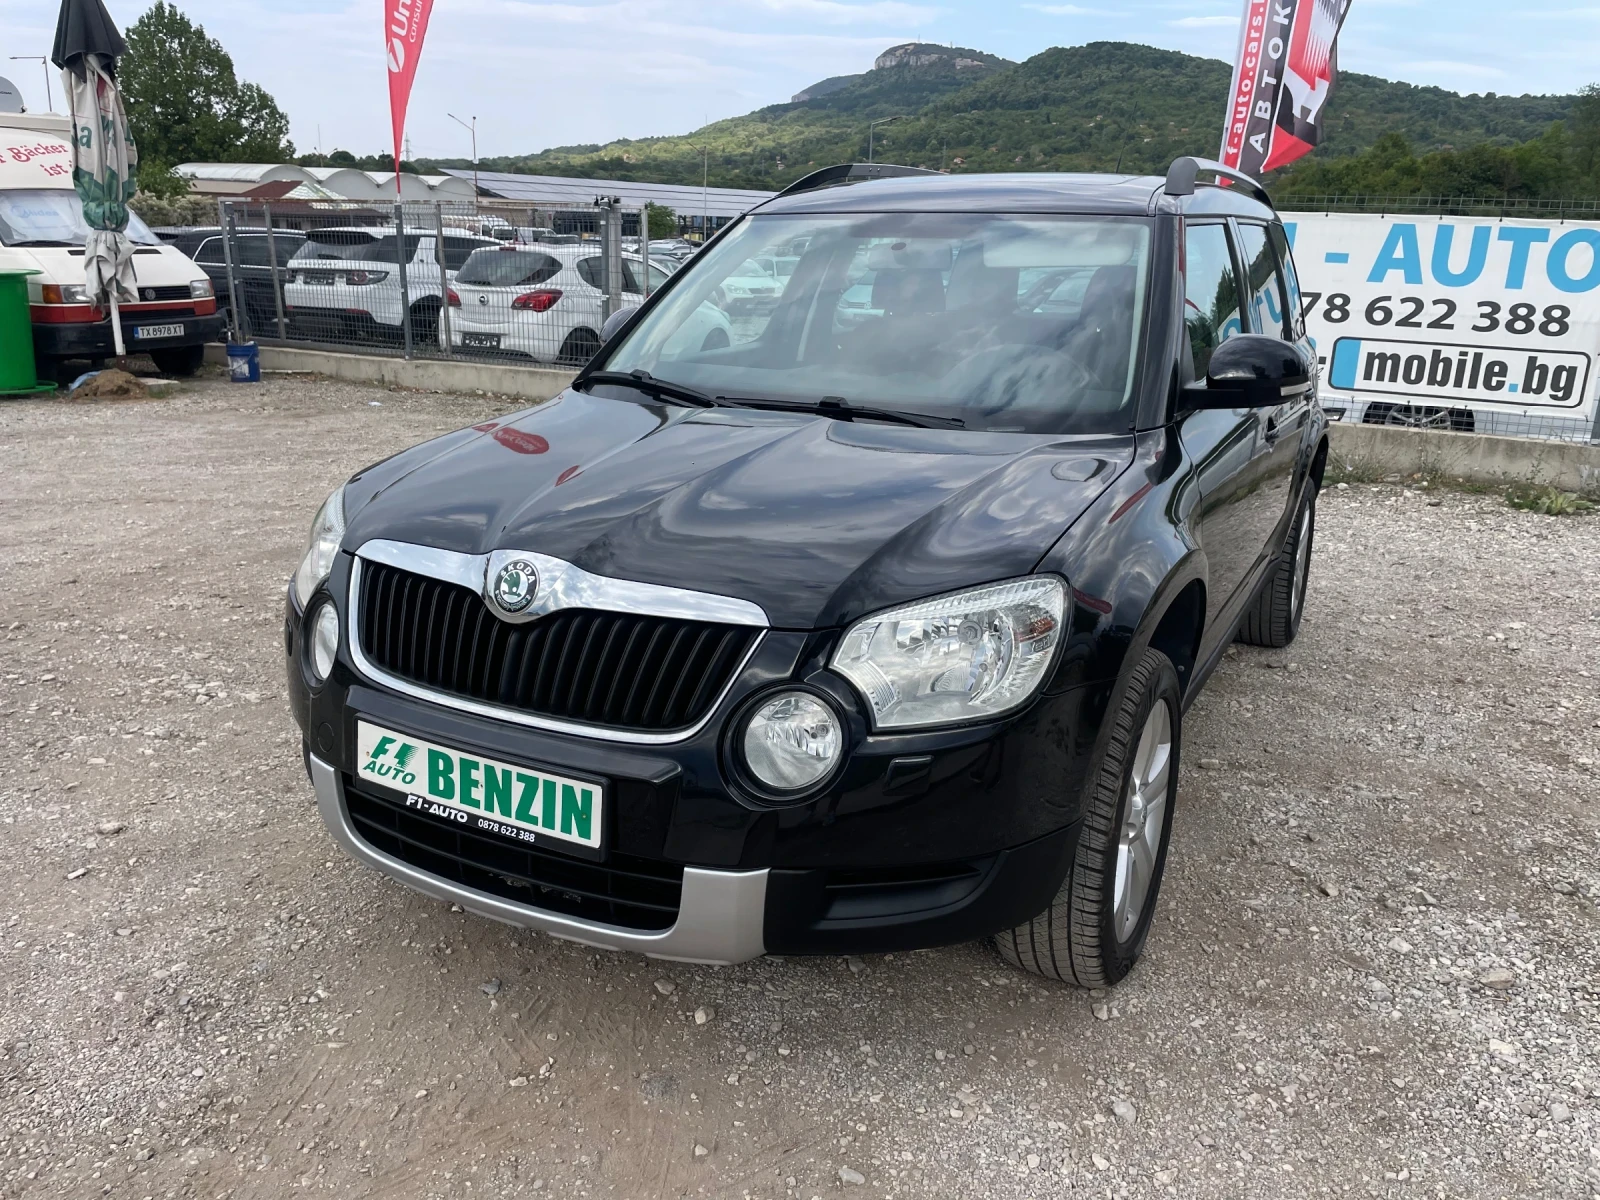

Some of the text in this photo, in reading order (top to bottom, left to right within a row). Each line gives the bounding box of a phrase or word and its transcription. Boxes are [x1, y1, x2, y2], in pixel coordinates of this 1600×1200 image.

[1227, 0, 1265, 155] f-auto.cars.
[6, 143, 69, 163] Bäcker
[40, 164, 69, 176] ist
[1366, 223, 1600, 293] AUTO
[1364, 295, 1457, 330] 622
[1471, 301, 1571, 337] 388
[139, 325, 183, 337] TX 8978 XT
[1363, 349, 1578, 401] mobile.bg
[363, 760, 416, 784] AUTO
[428, 748, 593, 840] BENZIN
[406, 795, 468, 823] F1-AUTO
[478, 818, 536, 842] 0878 622 388
